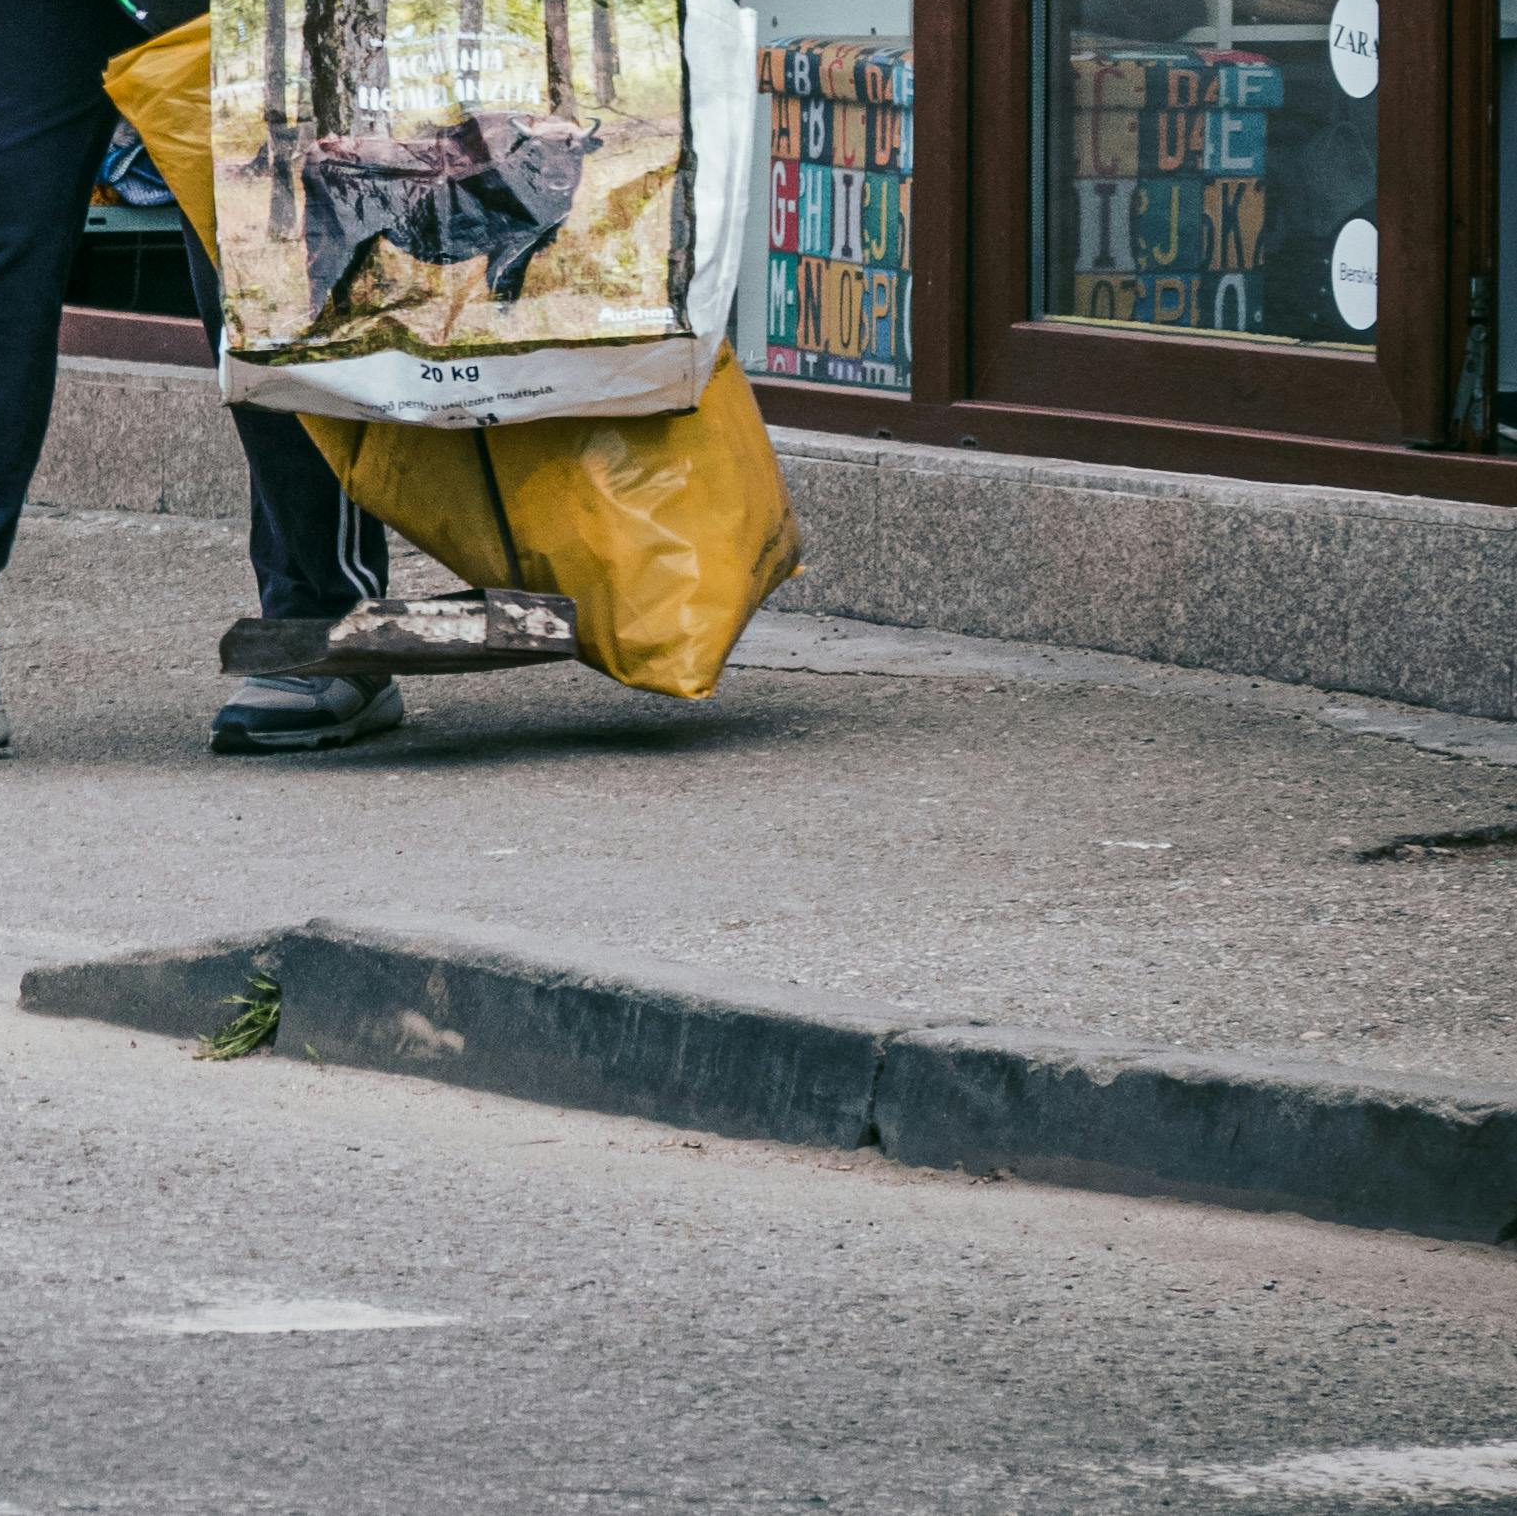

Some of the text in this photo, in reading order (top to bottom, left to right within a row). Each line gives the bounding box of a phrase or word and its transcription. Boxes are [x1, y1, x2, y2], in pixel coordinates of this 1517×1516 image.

[1334, 24, 1380, 60] ZARA
[420, 363, 480, 383] 20 kg
[397, 398, 439, 413] pentru
